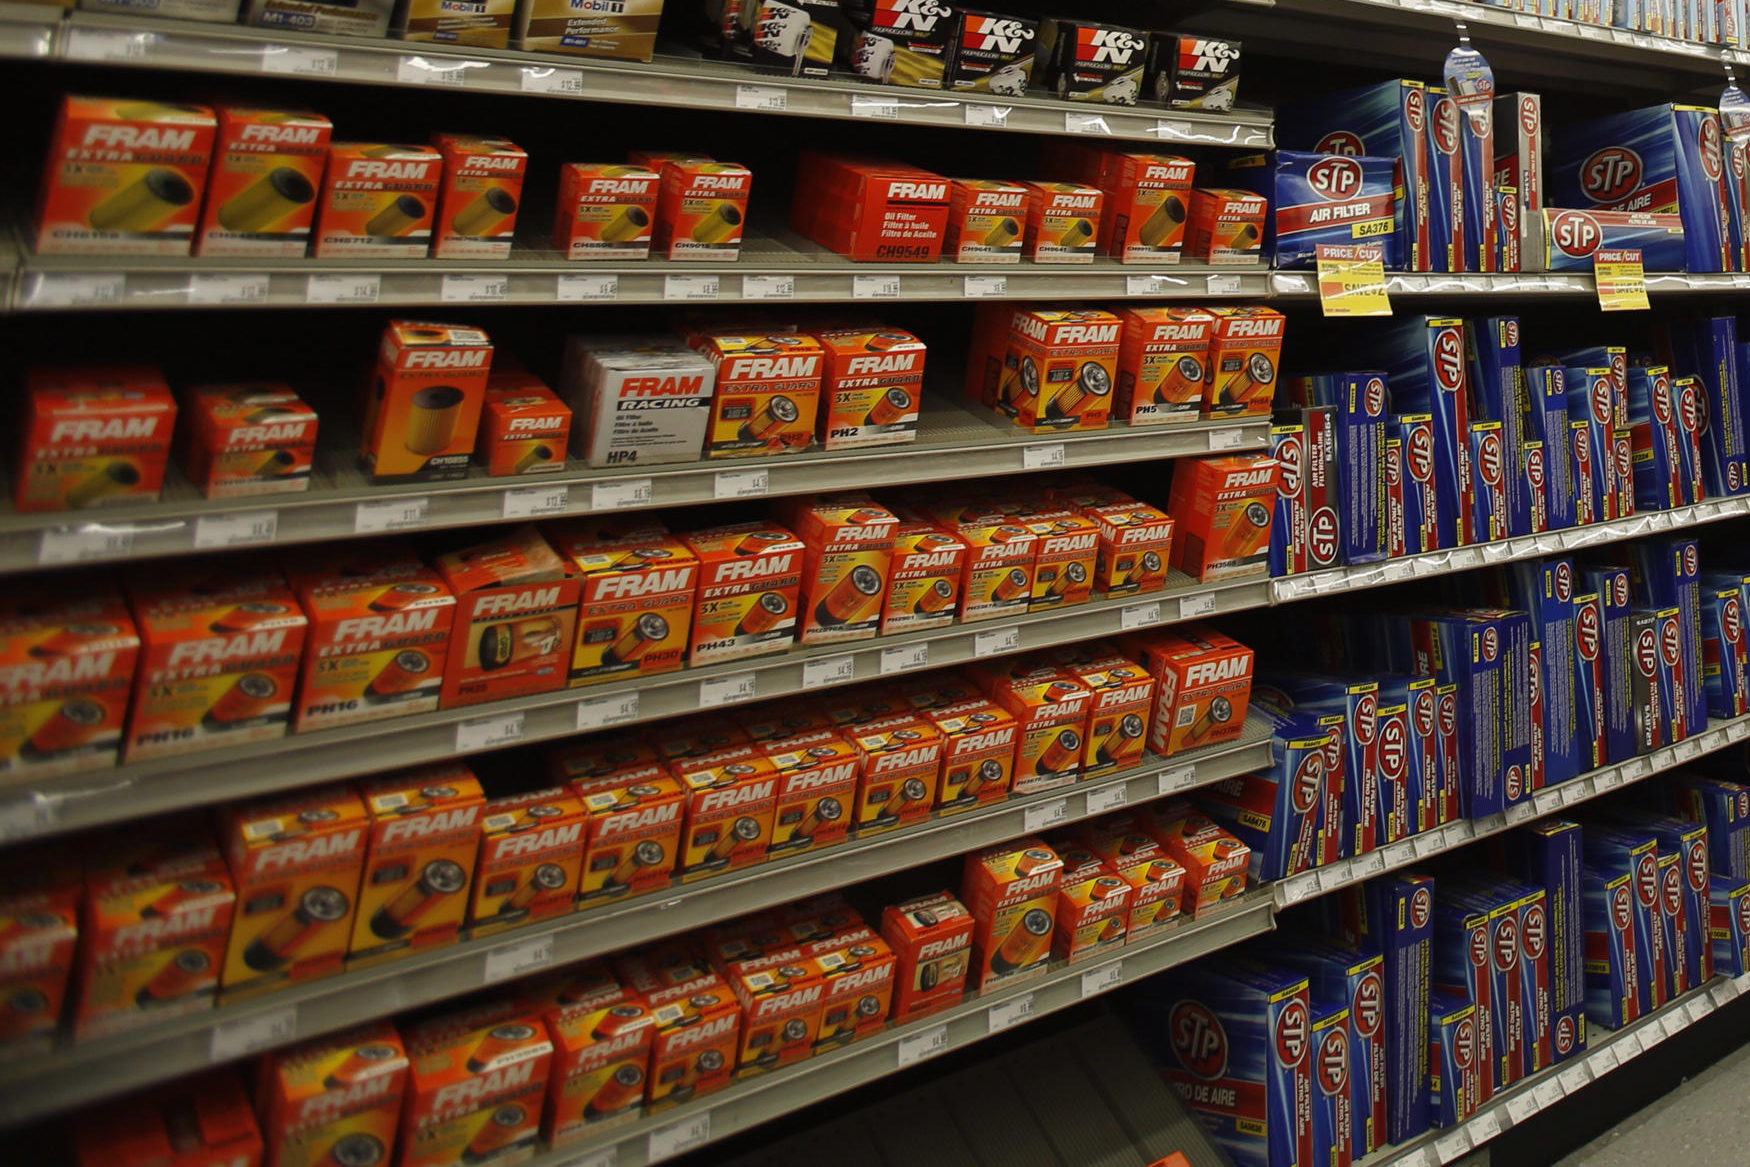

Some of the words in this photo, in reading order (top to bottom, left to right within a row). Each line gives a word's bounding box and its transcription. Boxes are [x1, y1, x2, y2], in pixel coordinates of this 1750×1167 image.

[265, 0, 314, 14] Extended
[315, 4, 379, 21] Performance
[980, 16, 1035, 53] K&N
[1089, 28, 1145, 64] K&N
[348, 161, 428, 179] FRAM
[465, 156, 519, 170] FRAM
[1145, 166, 1188, 180] FRAM
[1315, 162, 1355, 193] STP
[1588, 155, 1634, 192] STP
[589, 180, 649, 194] FRAM
[693, 176, 744, 190] FRAM
[888, 183, 946, 200] FRAM
[975, 193, 1022, 206] FRAM
[1052, 195, 1096, 208] FRAM
[1224, 202, 1261, 214] FRAM
[1627, 193, 1651, 211] AIRE
[885, 212, 896, 220] Oil
[897, 213, 916, 221] Filter
[1310, 208, 1331, 223] AIR
[1333, 203, 1370, 220] FILTER
[882, 230, 901, 238] Filtro
[902, 230, 912, 238] de
[913, 230, 936, 238] Aceite
[884, 221, 899, 229] Filtre
[911, 222, 929, 230] huile
[1359, 222, 1388, 235] SA376
[1560, 217, 1594, 248] STP
[876, 245, 930, 259] CH9549
[1012, 312, 1048, 341] FRAM
[1054, 324, 1119, 344] FRAM
[1153, 325, 1204, 340] FRAM
[1227, 320, 1281, 337] FRAM
[729, 356, 818, 379] FRAM
[848, 353, 916, 375] FRAM
[619, 375, 704, 397] FRAM
[620, 398, 700, 409] RACING
[1136, 405, 1157, 414] PH5
[830, 427, 859, 439] PH2
[607, 450, 637, 464] HP4
[1280, 446, 1300, 489] STP
[1313, 516, 1334, 555] STP
[714, 554, 794, 582] FRAM
[593, 568, 693, 601] FRAM
[696, 639, 735, 653] PH43
[644, 650, 678, 663] PH30
[1185, 655, 1249, 687] FRAM
[1099, 684, 1152, 709] FRAM
[1151, 666, 1177, 749] FRAM
[1386, 728, 1403, 768] STP
[1301, 760, 1319, 804] STP
[1194, 1088, 1209, 1103] DE
[1211, 1088, 1236, 1107] AIRE
